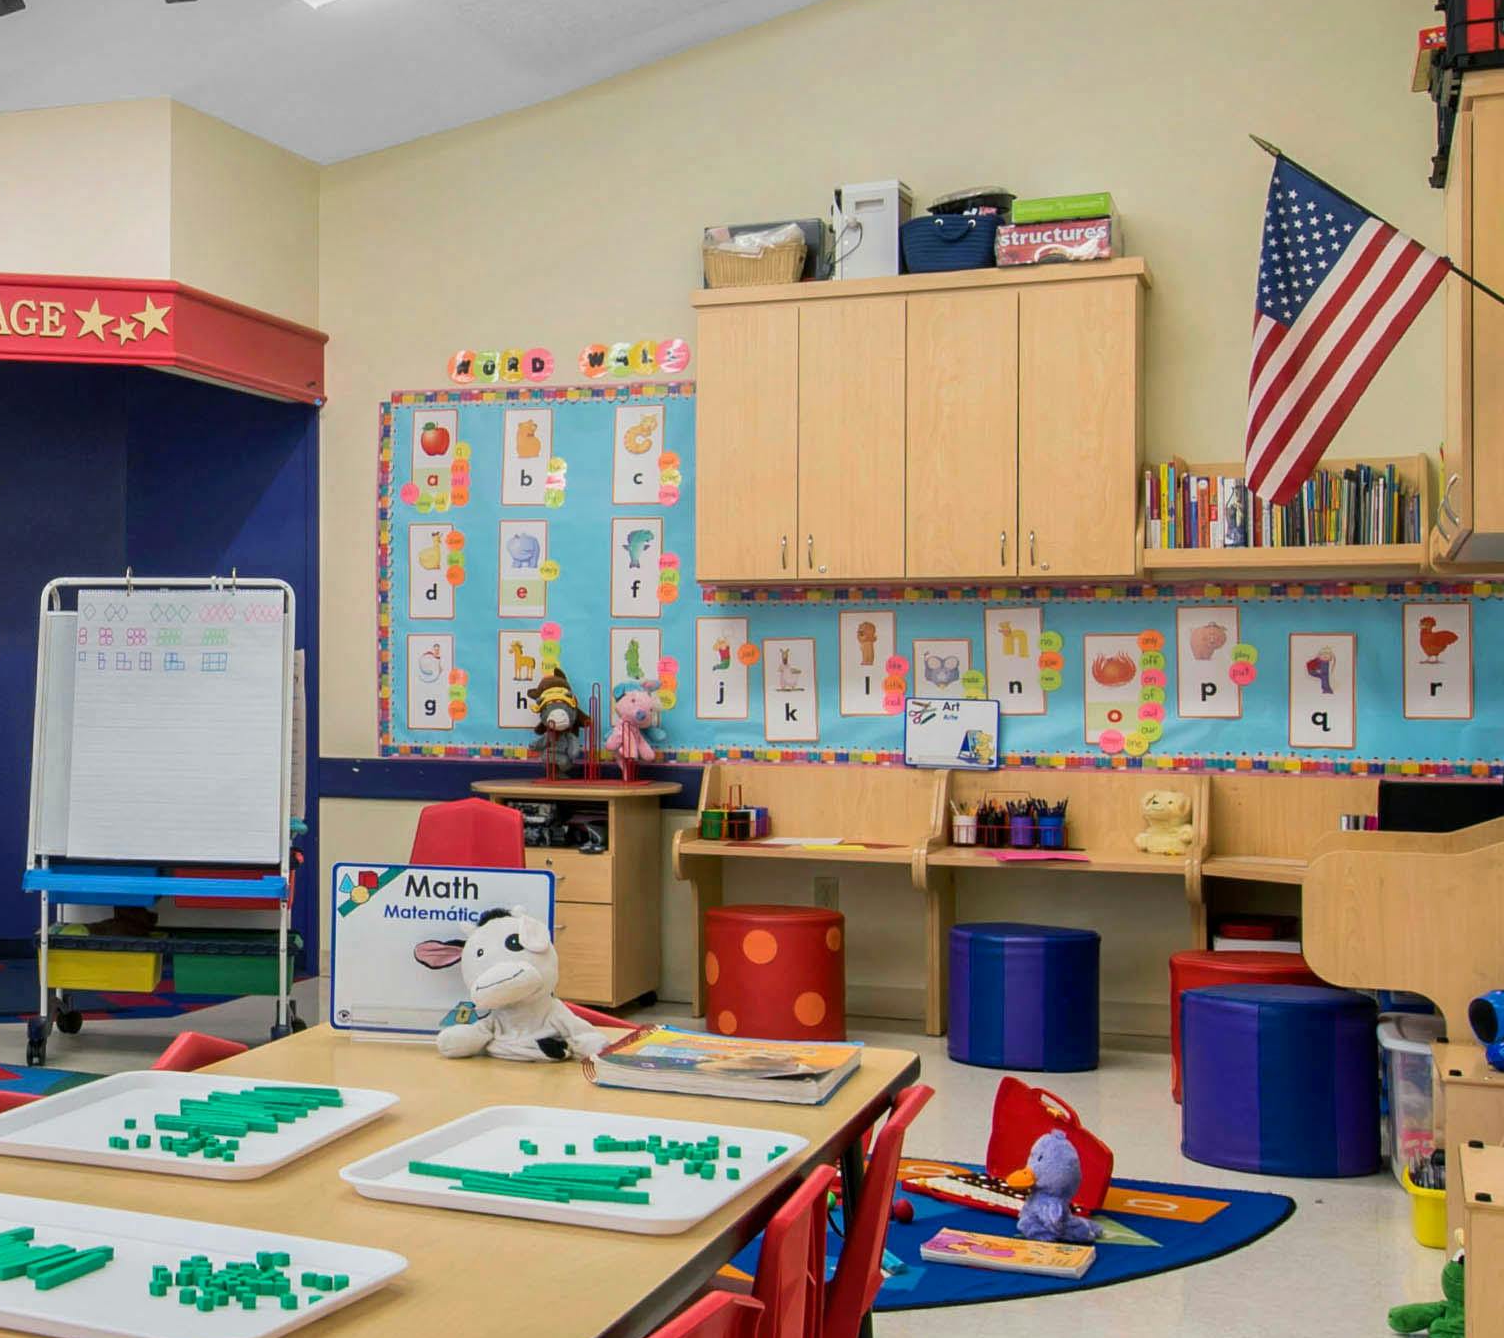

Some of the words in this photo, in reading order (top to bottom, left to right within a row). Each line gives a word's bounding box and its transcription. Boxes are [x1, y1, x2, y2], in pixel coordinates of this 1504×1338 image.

[999, 225, 1106, 246] structures
[427, 475, 438, 487] a
[521, 470, 532, 487] b
[633, 473, 643, 485] c
[426, 584, 437, 601] d
[516, 586, 528, 599] e
[630, 580, 640, 598] f
[424, 699, 436, 716] g
[516, 691, 528, 709] h
[715, 681, 725, 705] j
[785, 703, 798, 722] k
[1008, 680, 1023, 695] n
[1107, 709, 1122, 723] o
[1201, 682, 1217, 702] p
[1311, 710, 1330, 732] q
[1430, 680, 1442, 697] r
[942, 701, 960, 712] Art
[405, 874, 479, 900] Math
[384, 904, 482, 923] Matemátic
